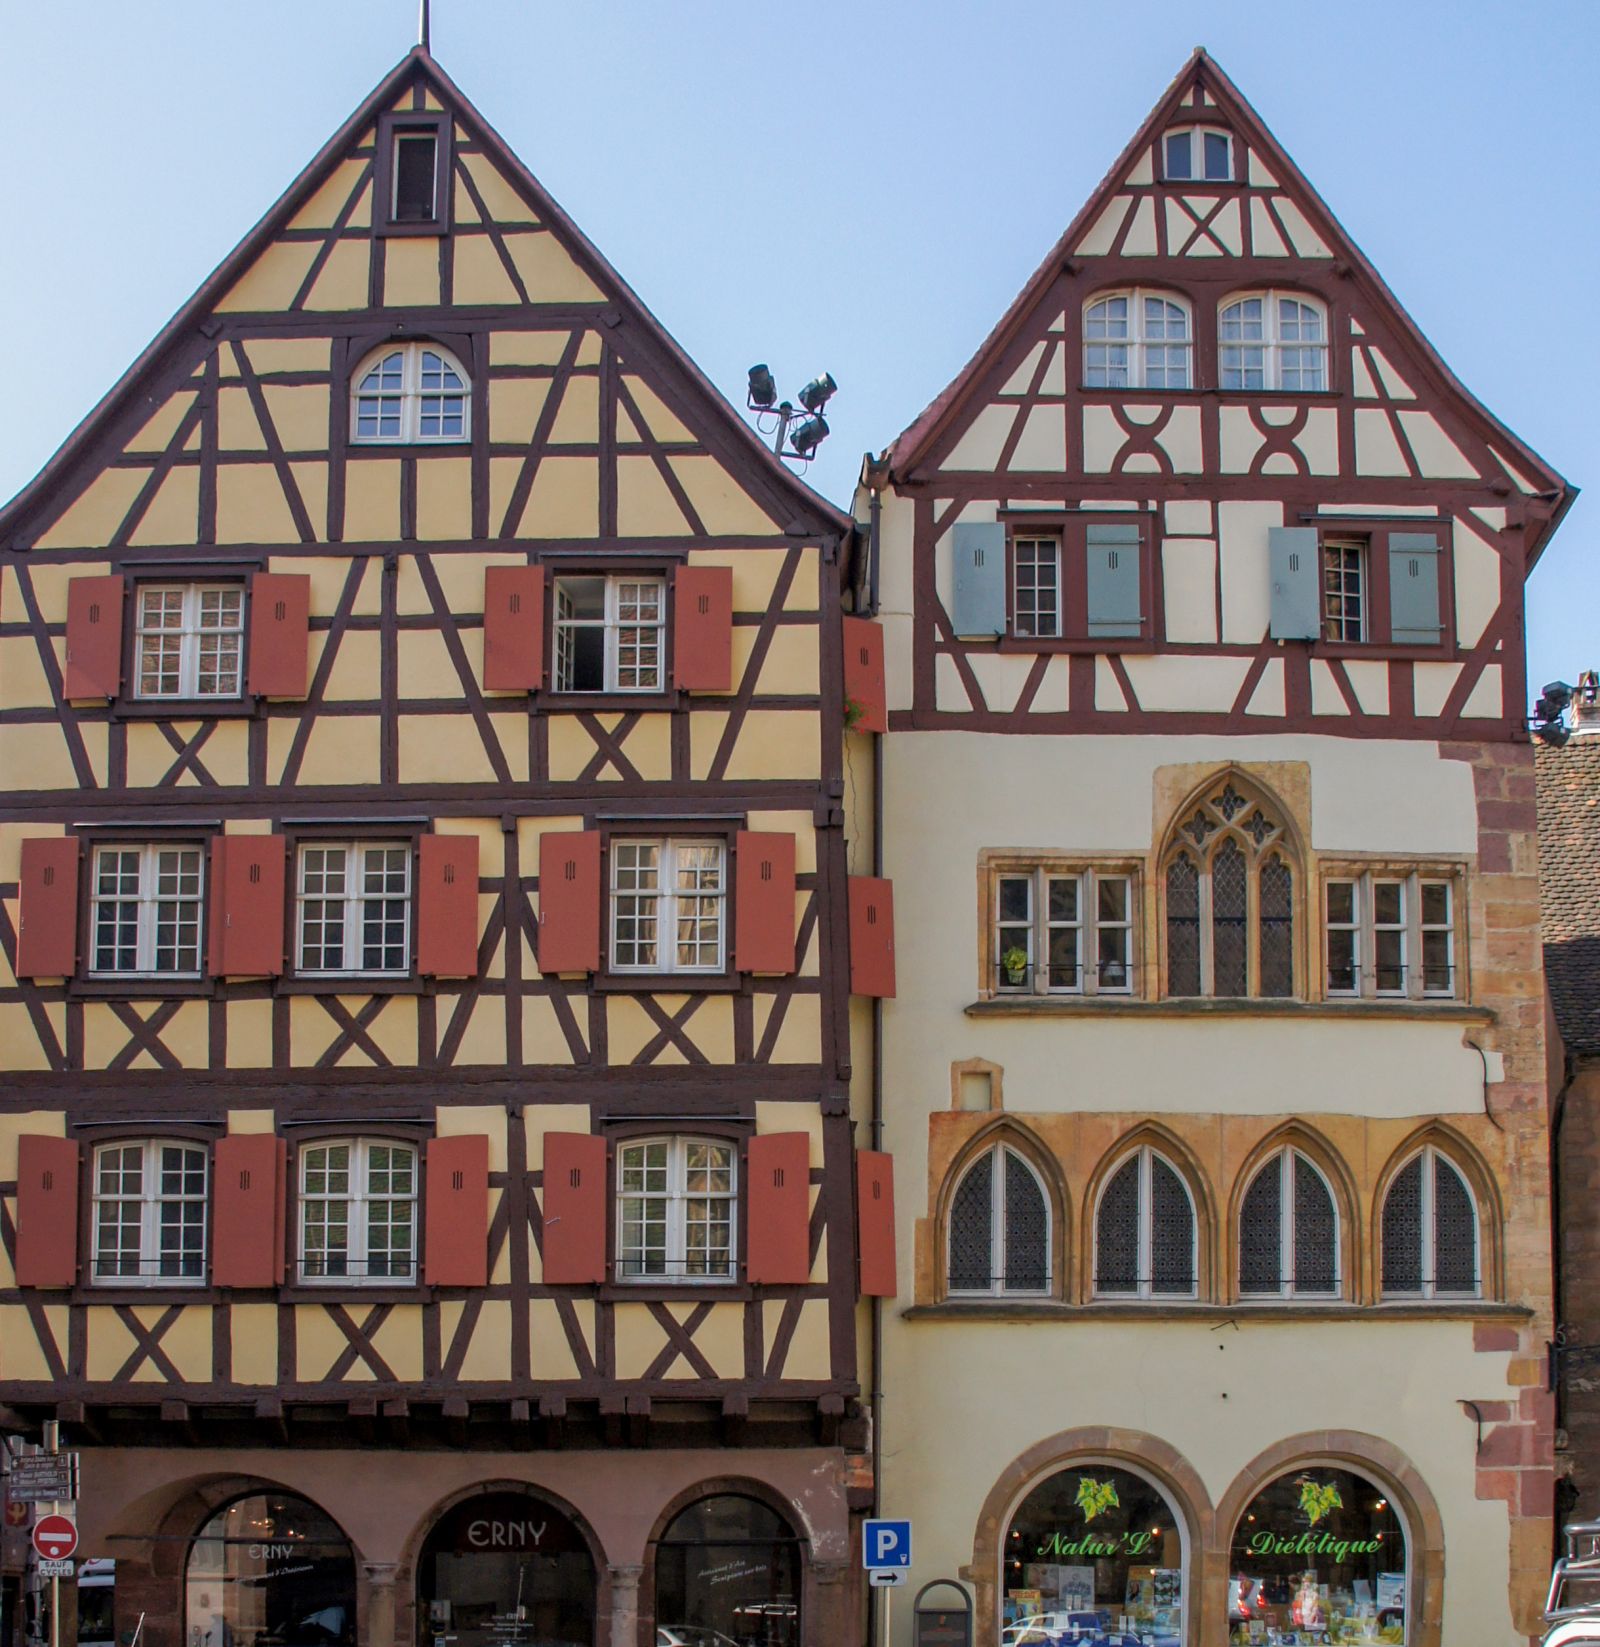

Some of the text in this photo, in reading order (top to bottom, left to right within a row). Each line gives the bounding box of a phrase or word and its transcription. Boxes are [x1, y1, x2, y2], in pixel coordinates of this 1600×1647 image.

[467, 1520, 547, 1546] ERNY
[877, 1529, 898, 1559] P
[1037, 1531, 1152, 1556] Natur'L
[248, 1544, 293, 1559] ERNY
[1250, 1531, 1384, 1563] Diététique
